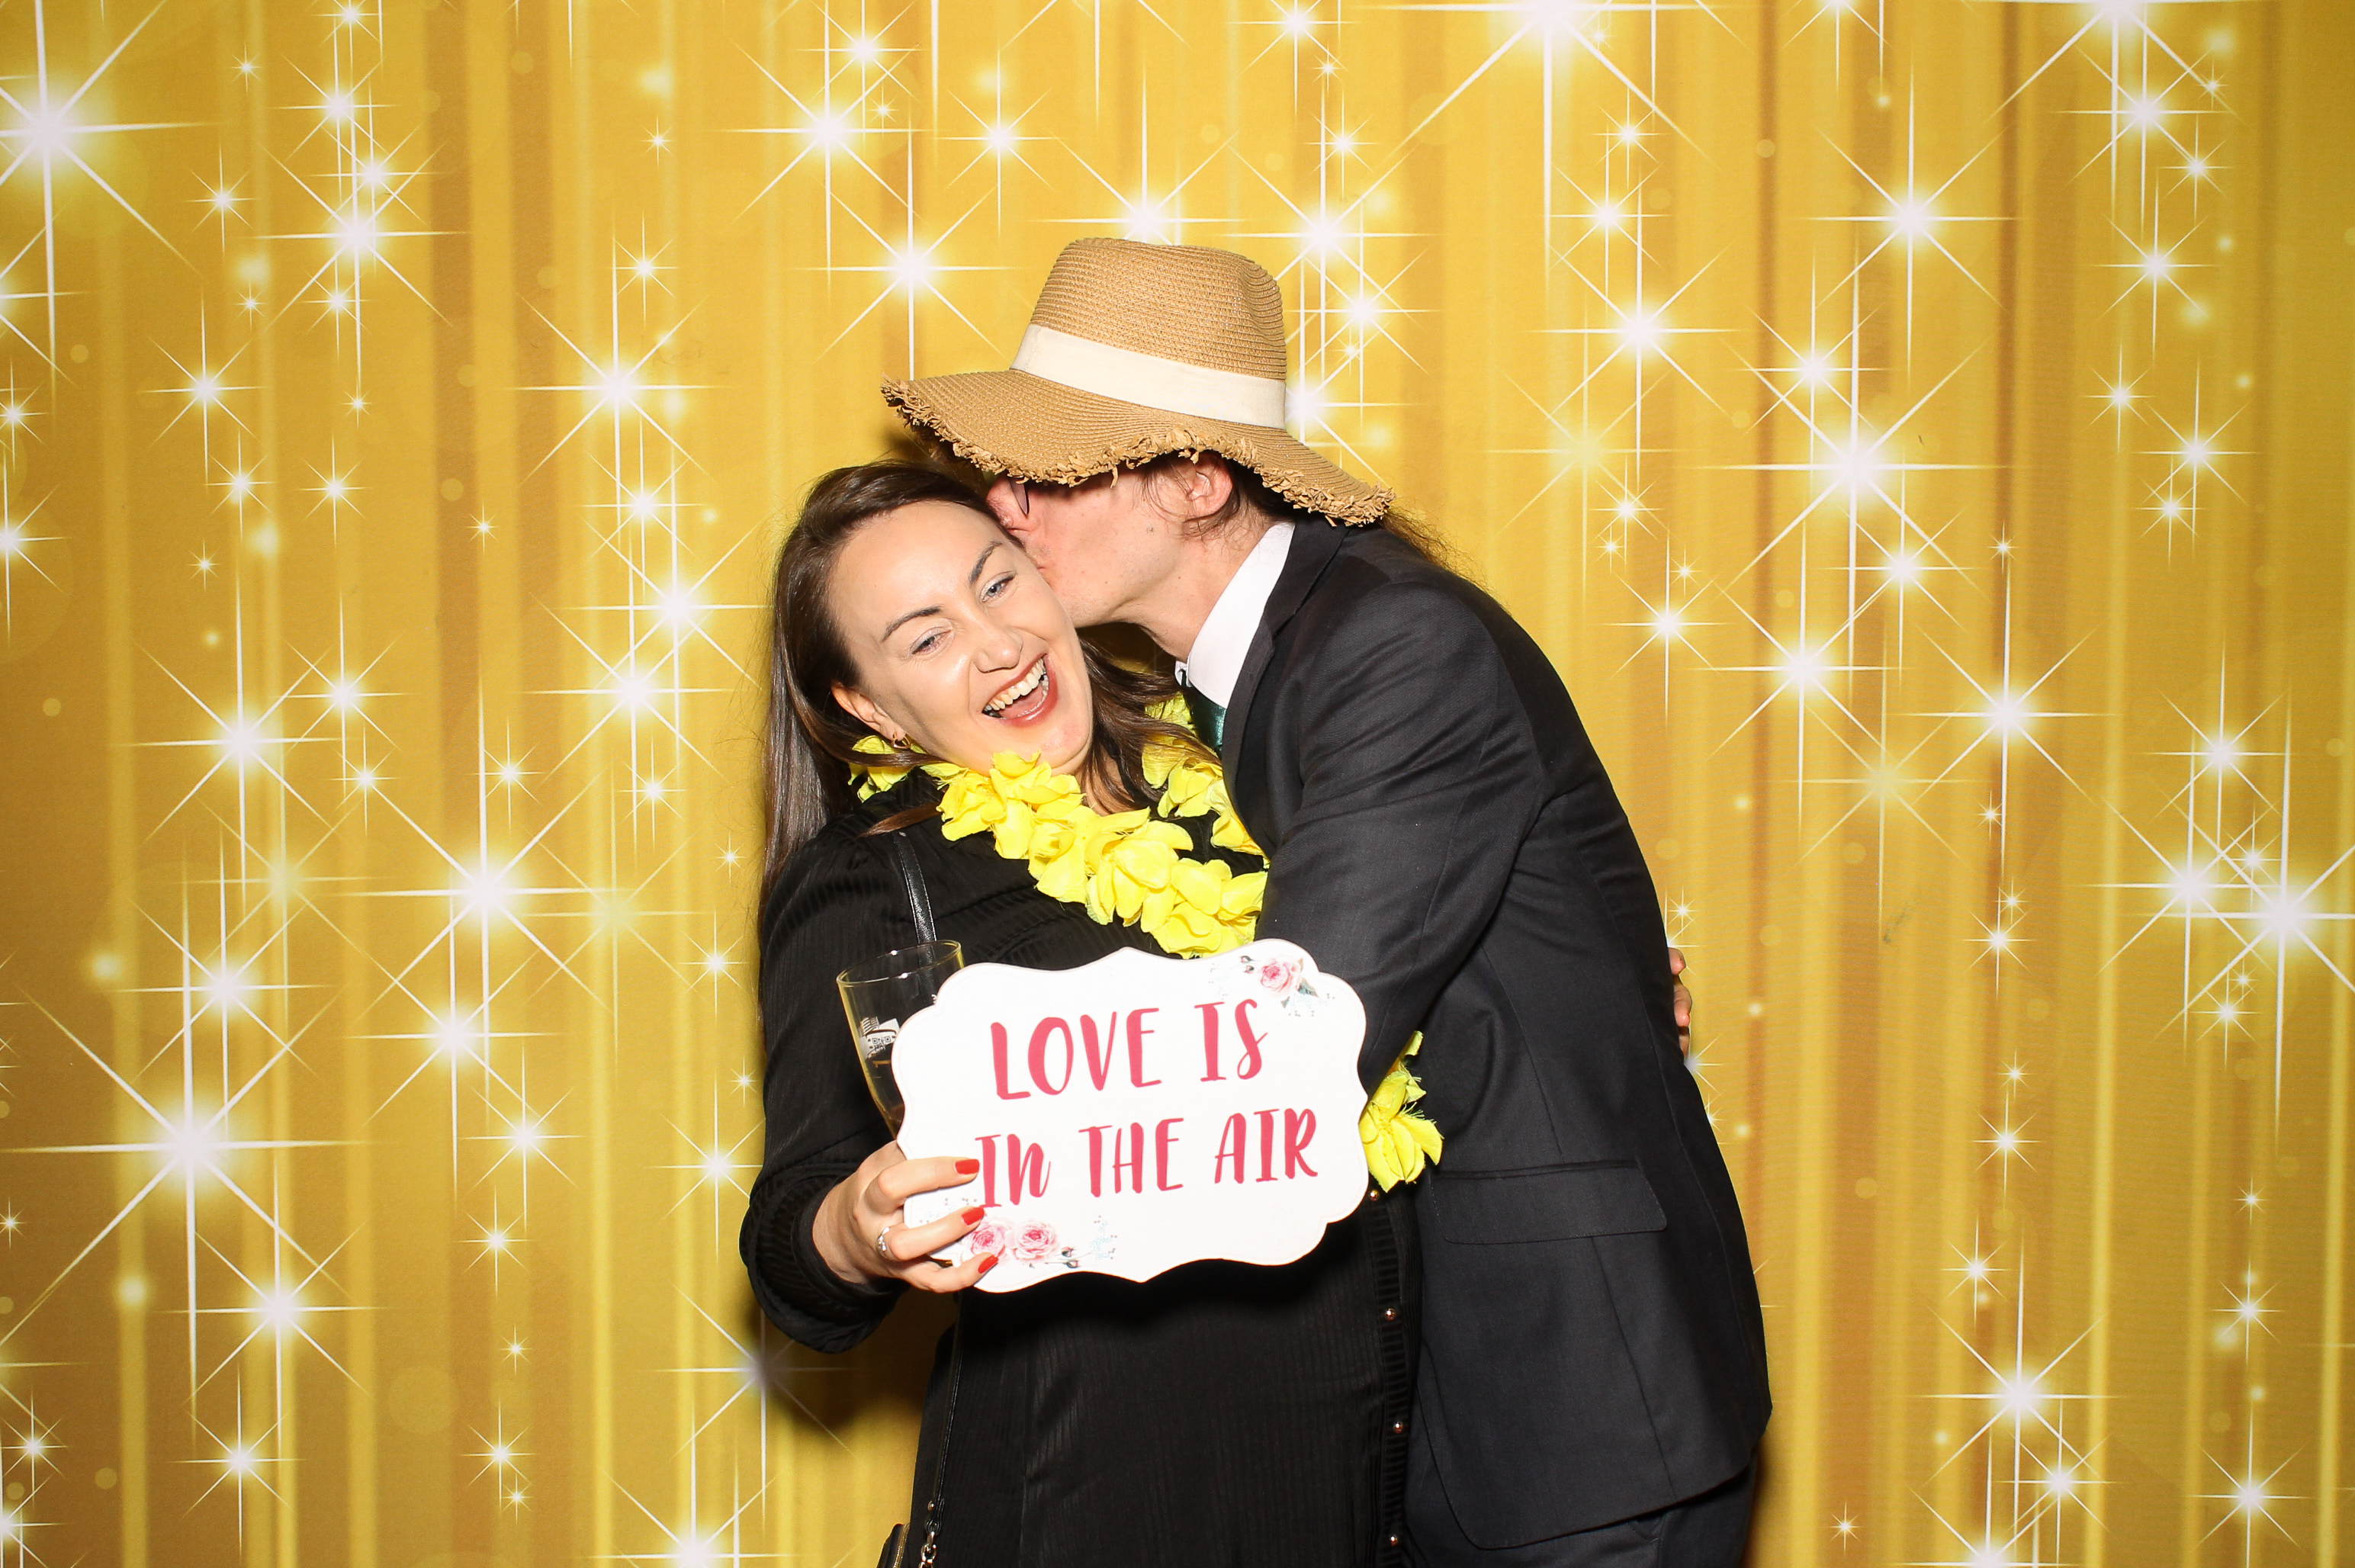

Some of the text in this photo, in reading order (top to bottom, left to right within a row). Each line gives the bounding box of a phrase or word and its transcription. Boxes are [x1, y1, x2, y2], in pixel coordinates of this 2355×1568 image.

[991, 998, 1267, 1100] LOVE IS
[1078, 1117, 1184, 1198] THE
[1214, 1107, 1319, 1184] AIR
